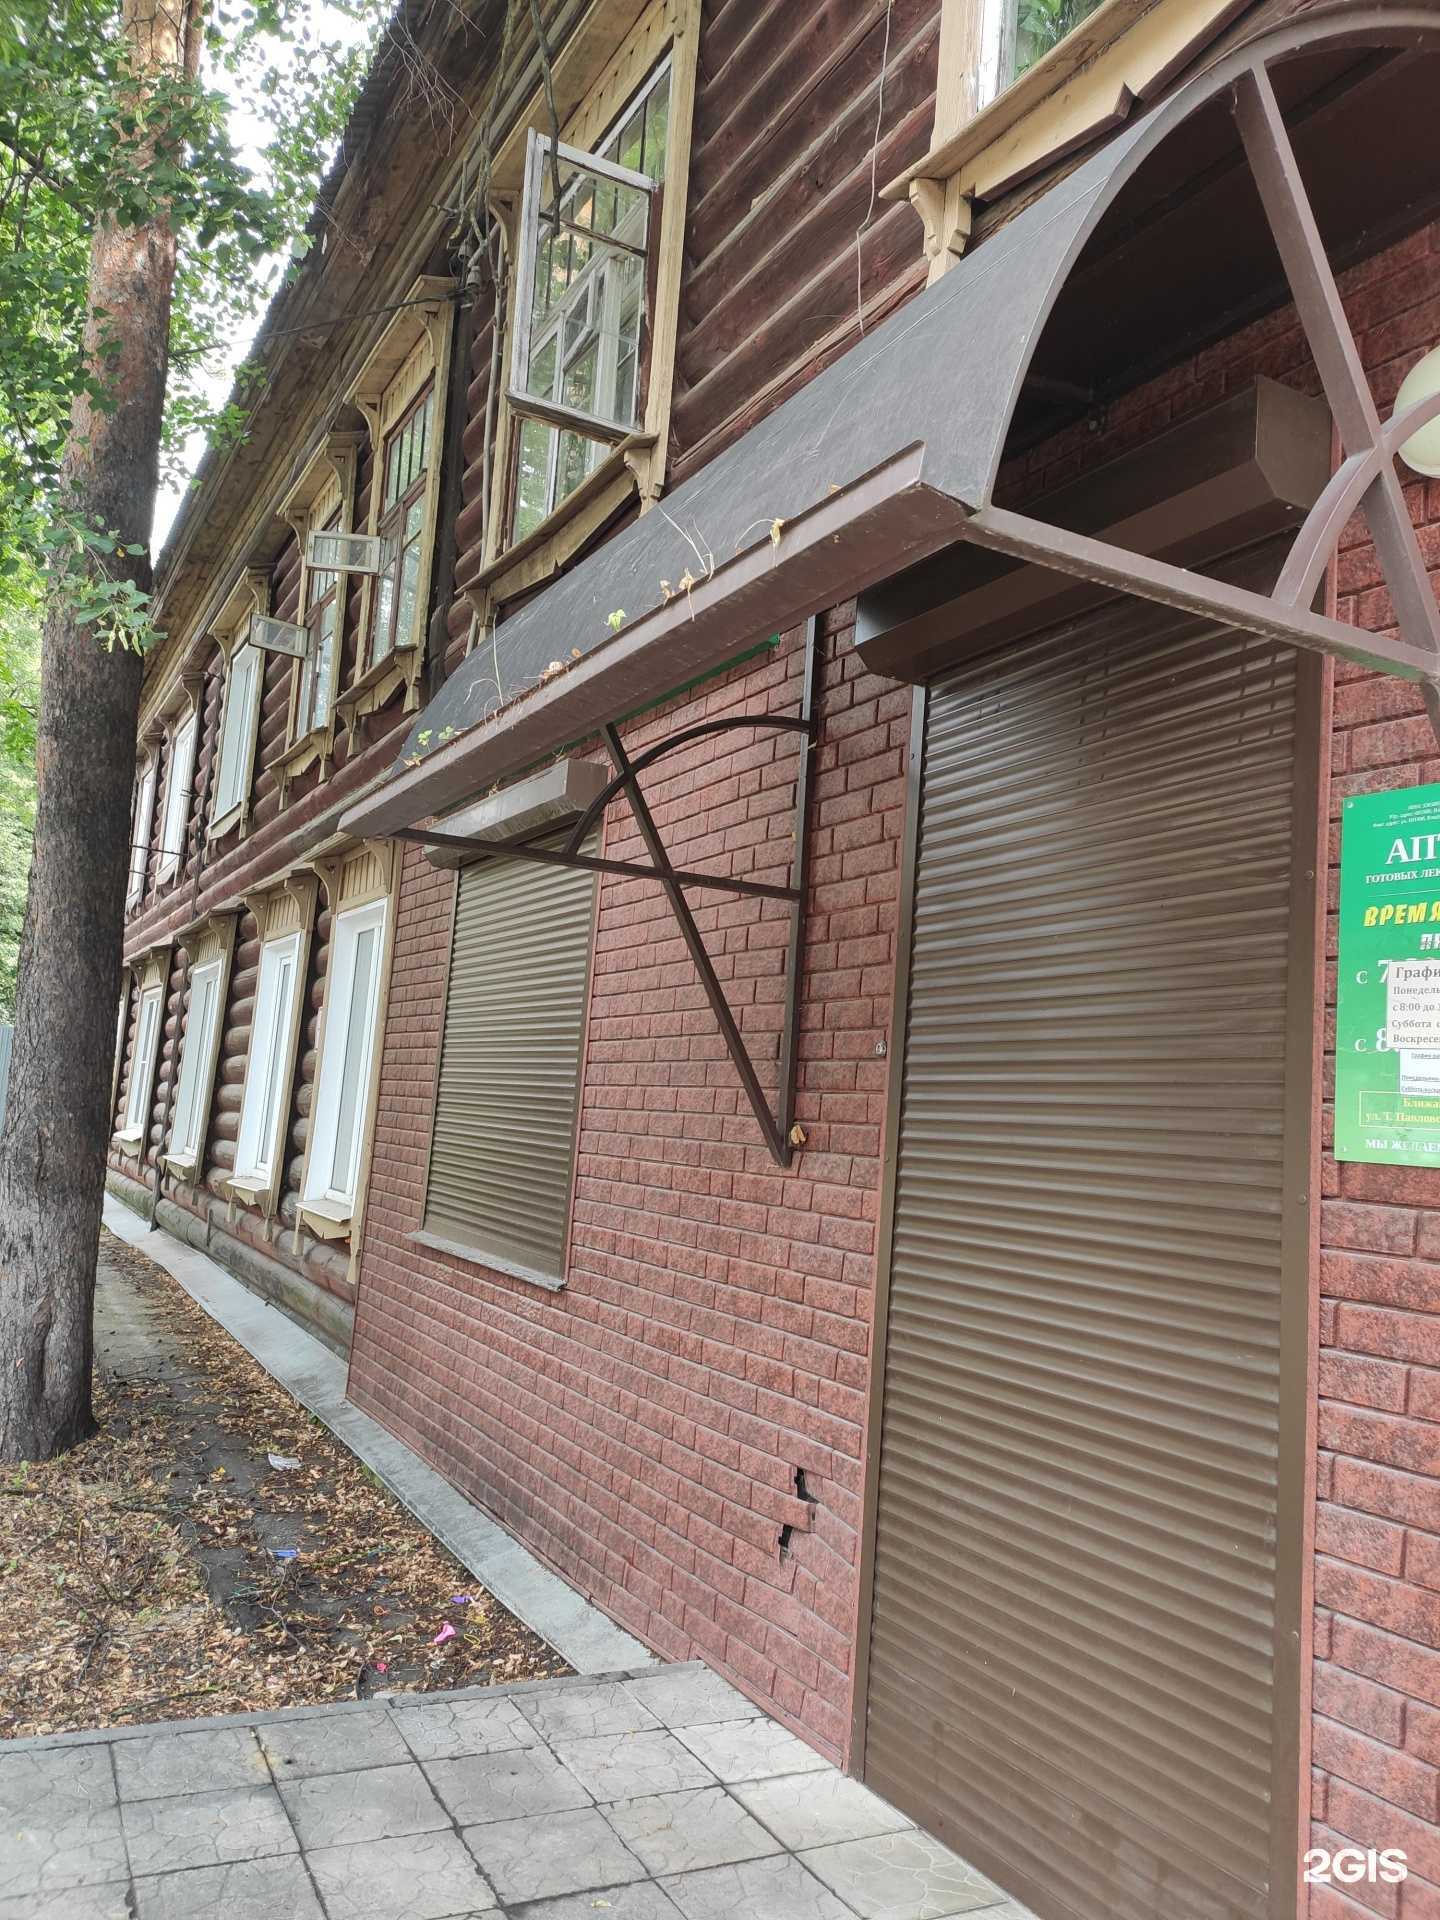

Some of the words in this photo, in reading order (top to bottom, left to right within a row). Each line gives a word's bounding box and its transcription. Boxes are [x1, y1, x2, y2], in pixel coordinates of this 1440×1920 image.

[1384, 833, 1440, 865] АП
[1365, 870, 1419, 884] ГОТОВЫХ
[1363, 901, 1440, 927] ВРЕМЯ
[1391, 1019, 1432, 1029] Суббота
[1393, 1034, 1440, 1045] Воскресе
